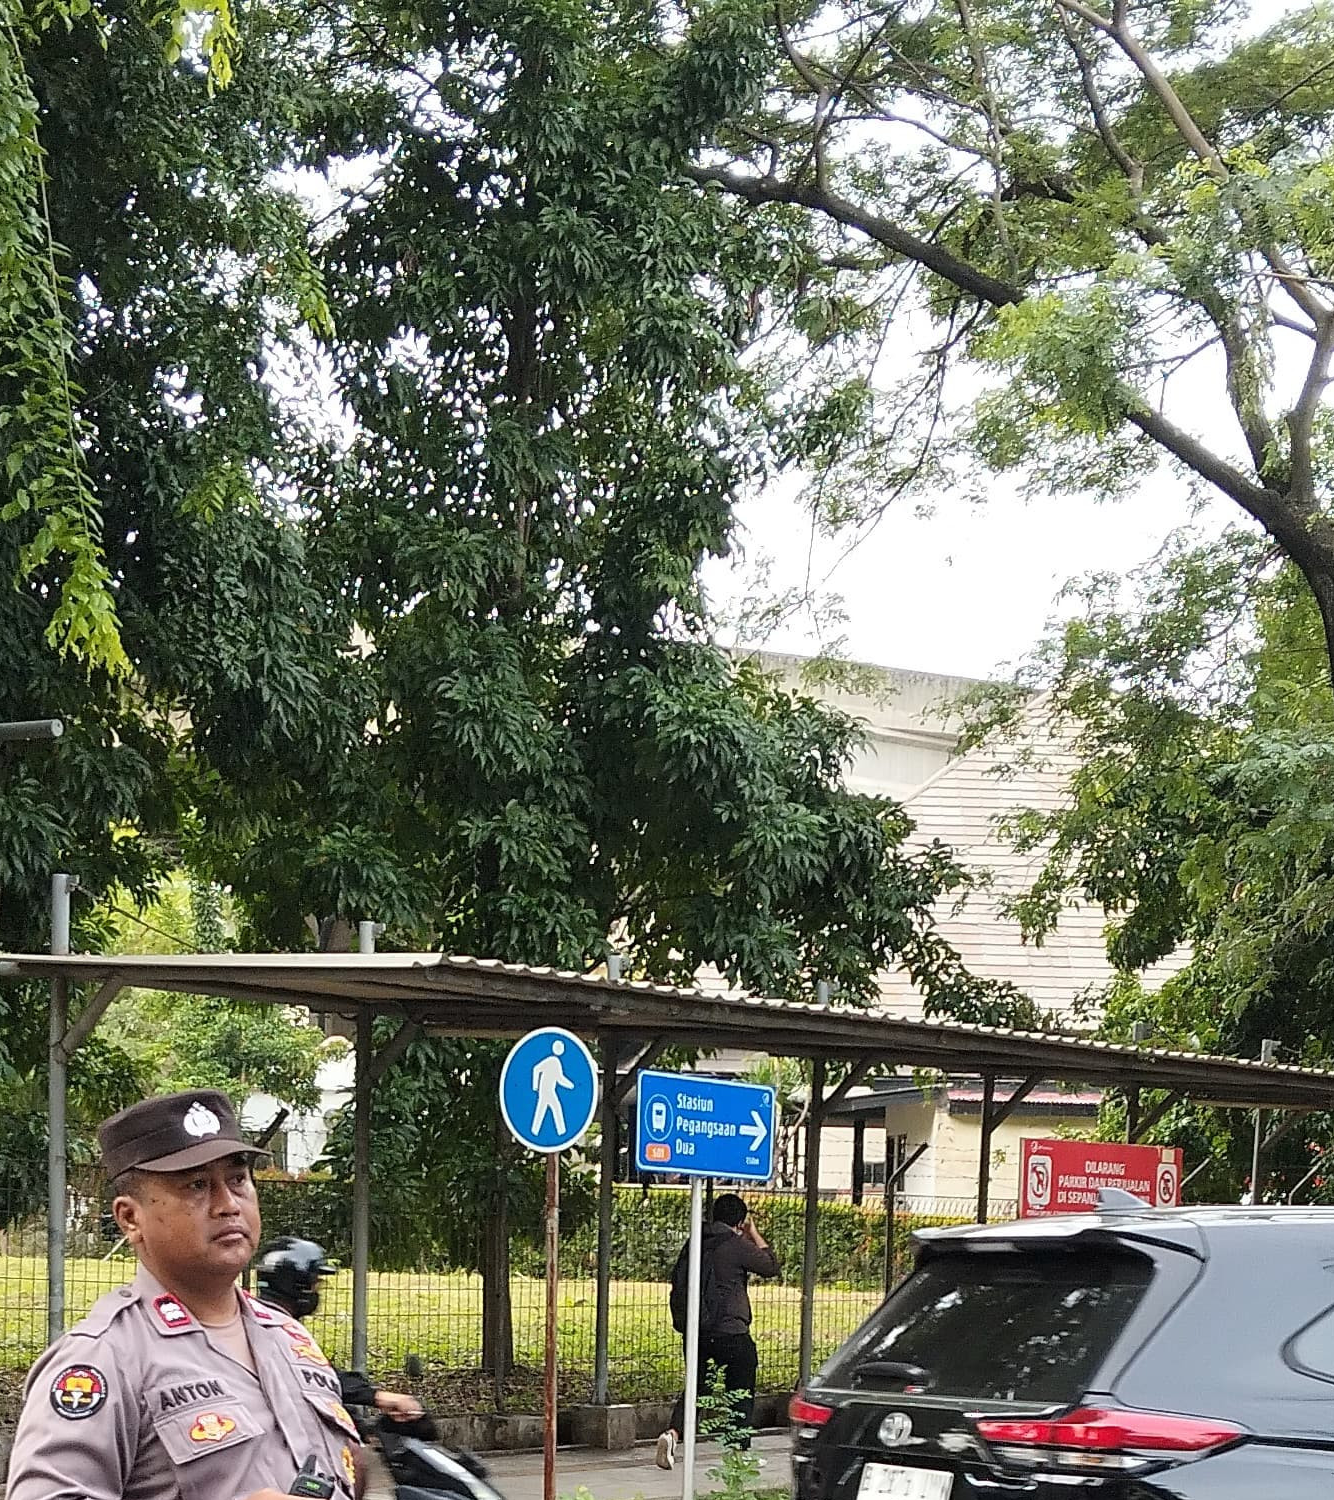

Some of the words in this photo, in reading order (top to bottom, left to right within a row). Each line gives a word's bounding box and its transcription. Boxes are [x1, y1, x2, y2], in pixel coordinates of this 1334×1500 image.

[676, 1093, 714, 1112] Stasiun
[676, 1116, 736, 1138] Pegangsaan
[675, 1138, 695, 1155] Dua
[1085, 1160, 1126, 1175] DILARANG
[1058, 1175, 1087, 1188] PARKIR
[160, 1380, 226, 1411] ANTON
